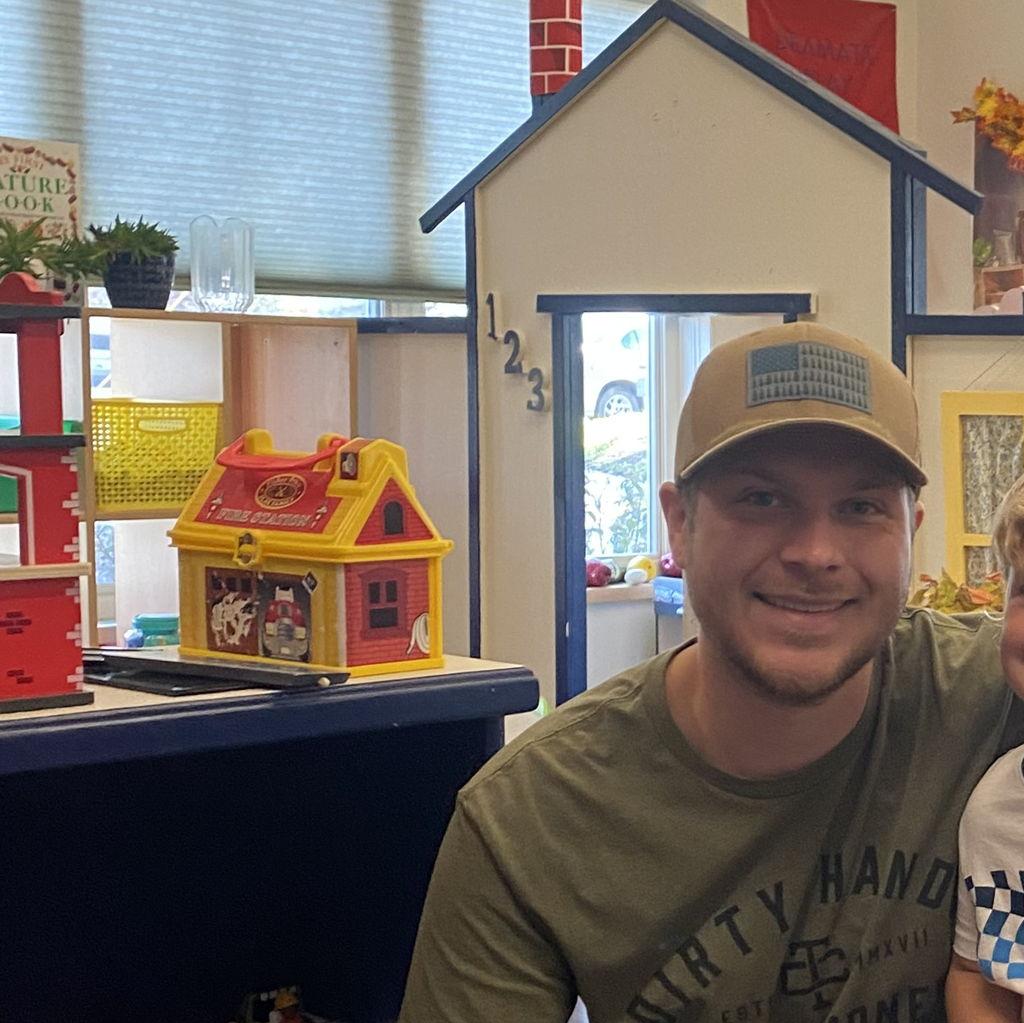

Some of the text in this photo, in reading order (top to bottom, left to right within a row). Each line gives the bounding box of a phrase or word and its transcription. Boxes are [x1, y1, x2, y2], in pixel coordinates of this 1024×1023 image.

[485, 293, 545, 412] 1 2 3
[820, 846, 957, 915] HAND
